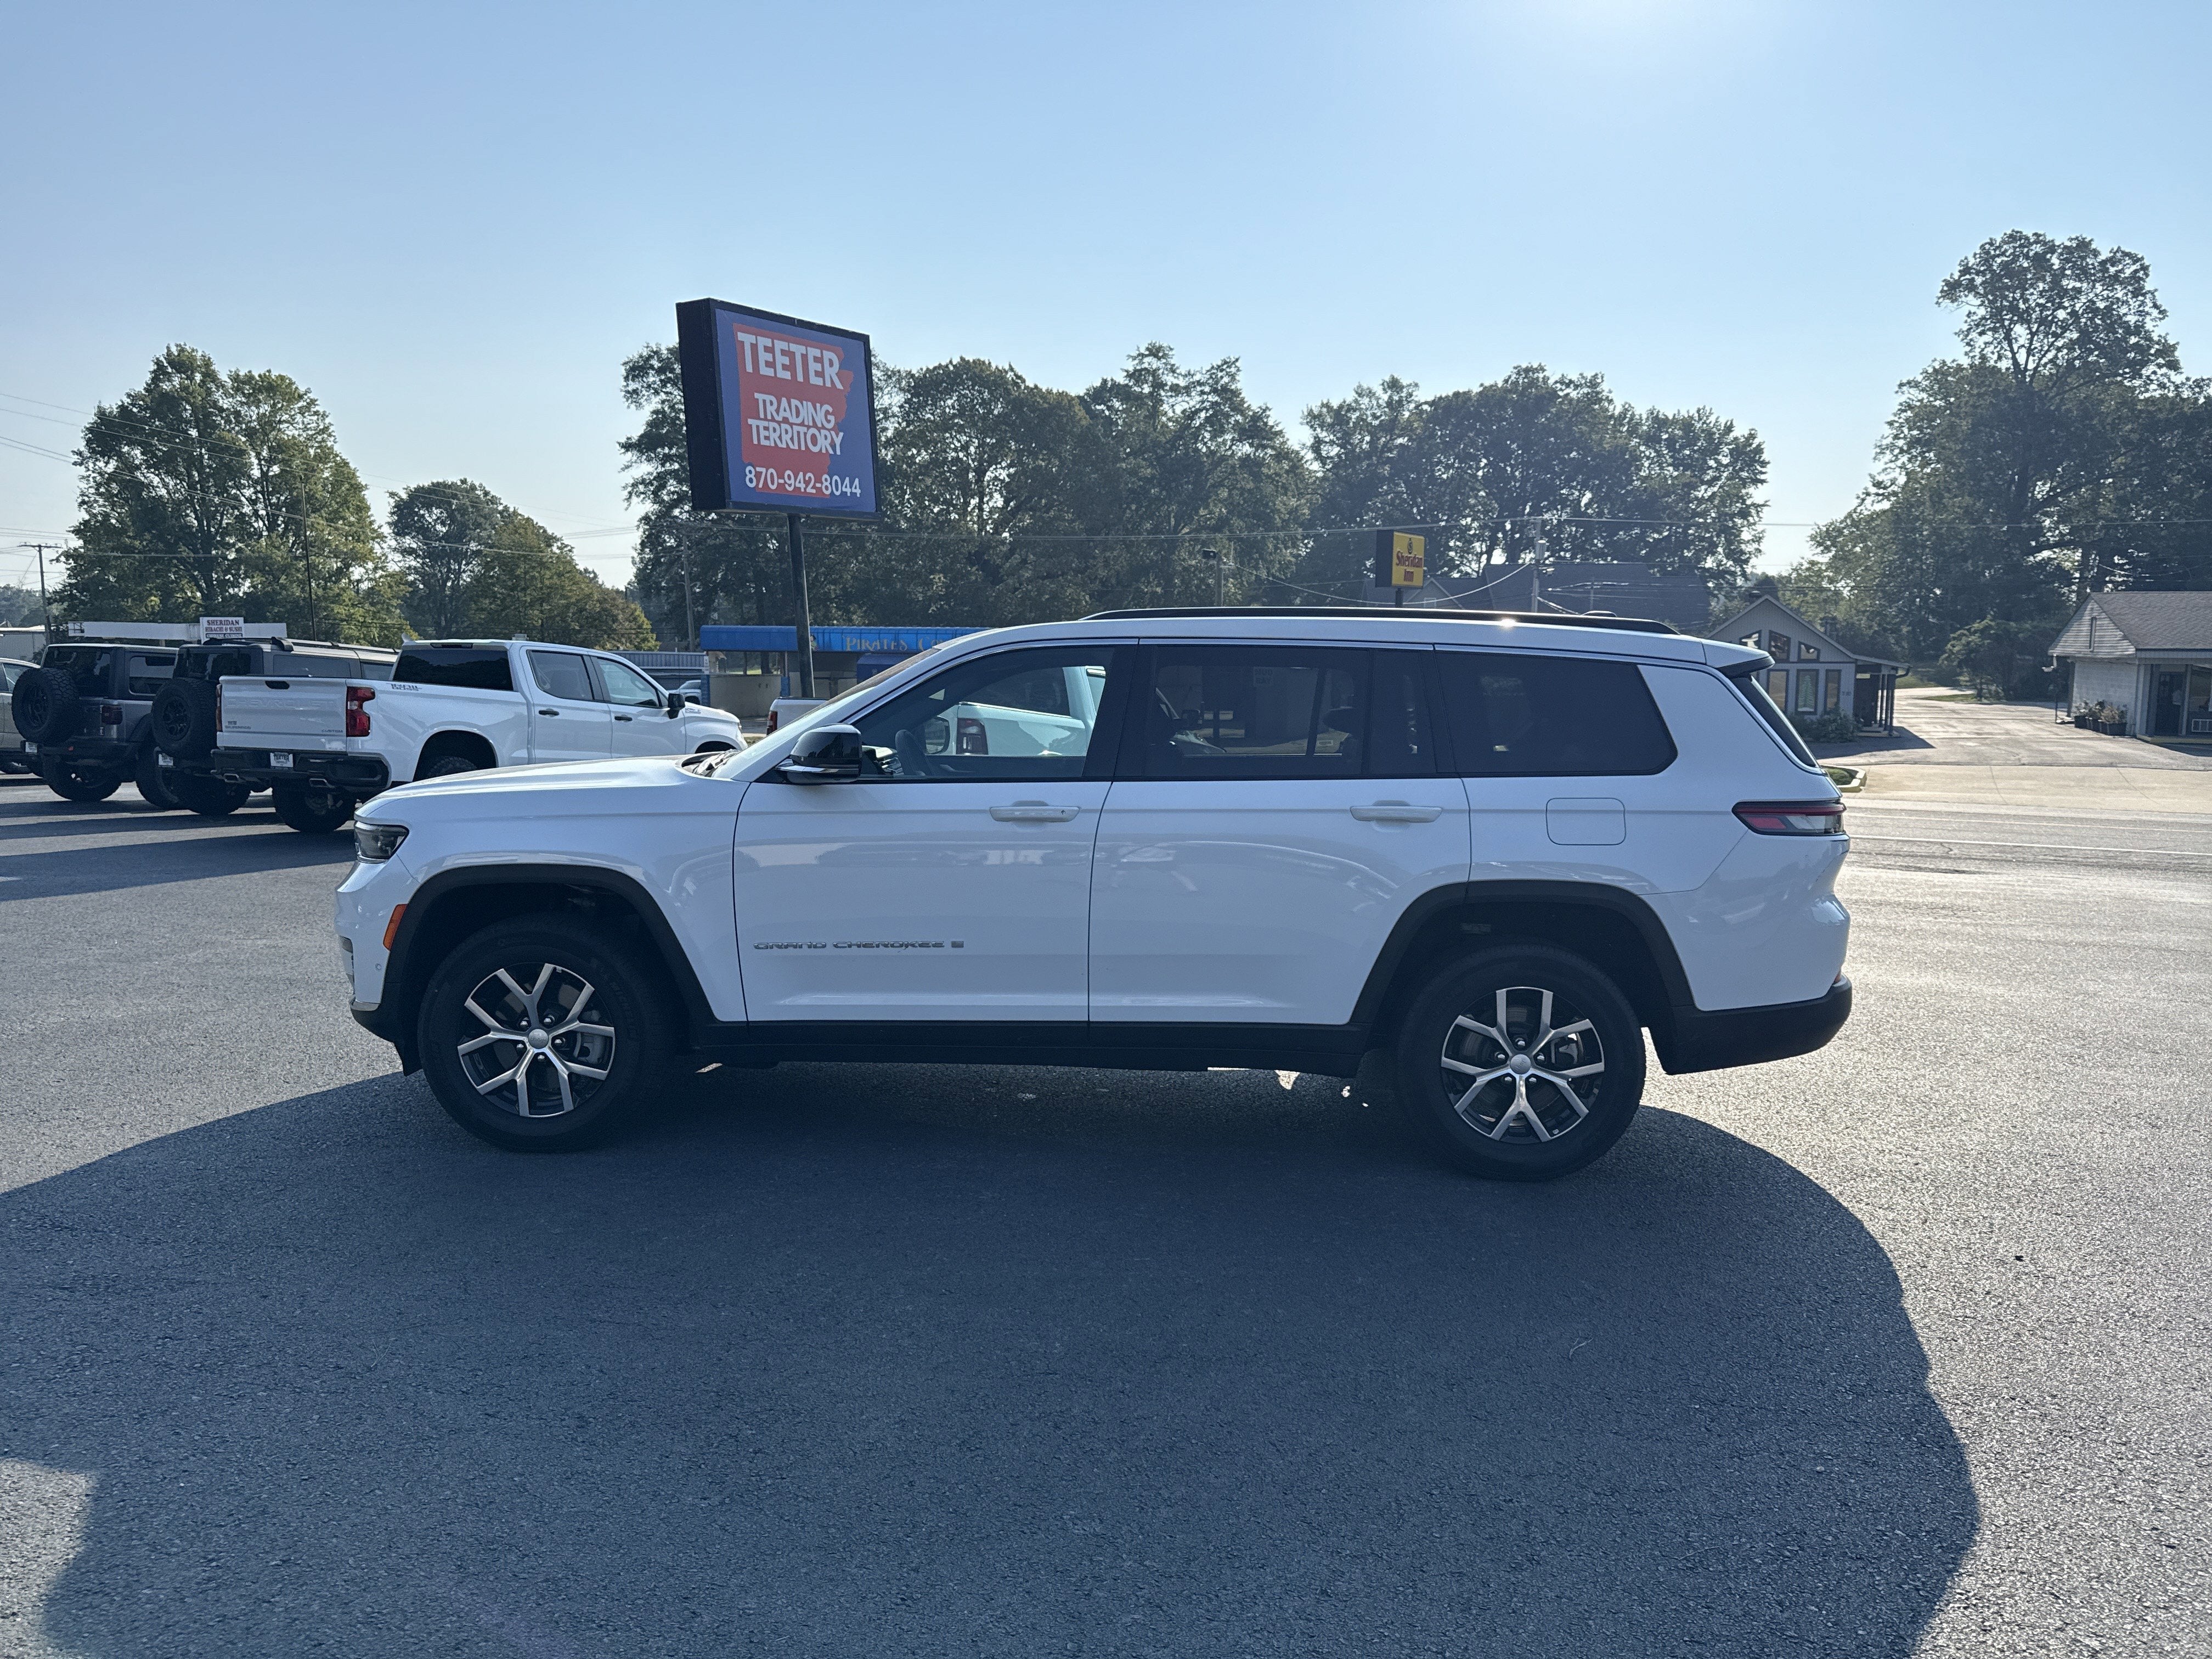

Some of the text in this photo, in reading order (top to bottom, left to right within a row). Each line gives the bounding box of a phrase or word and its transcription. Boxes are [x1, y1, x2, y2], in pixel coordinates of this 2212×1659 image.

[737, 331, 844, 390] TEETER
[754, 392, 836, 428] TRADING
[747, 418, 844, 455] TERRITORY
[745, 465, 861, 498] 870-942-8044
[1396, 550, 1423, 567] Sheridan
[1403, 568, 1414, 582] Inn
[846, 637, 907, 651] PIRATES
[753, 941, 827, 950] GRAND
[833, 940, 945, 950] CHEROKEE
